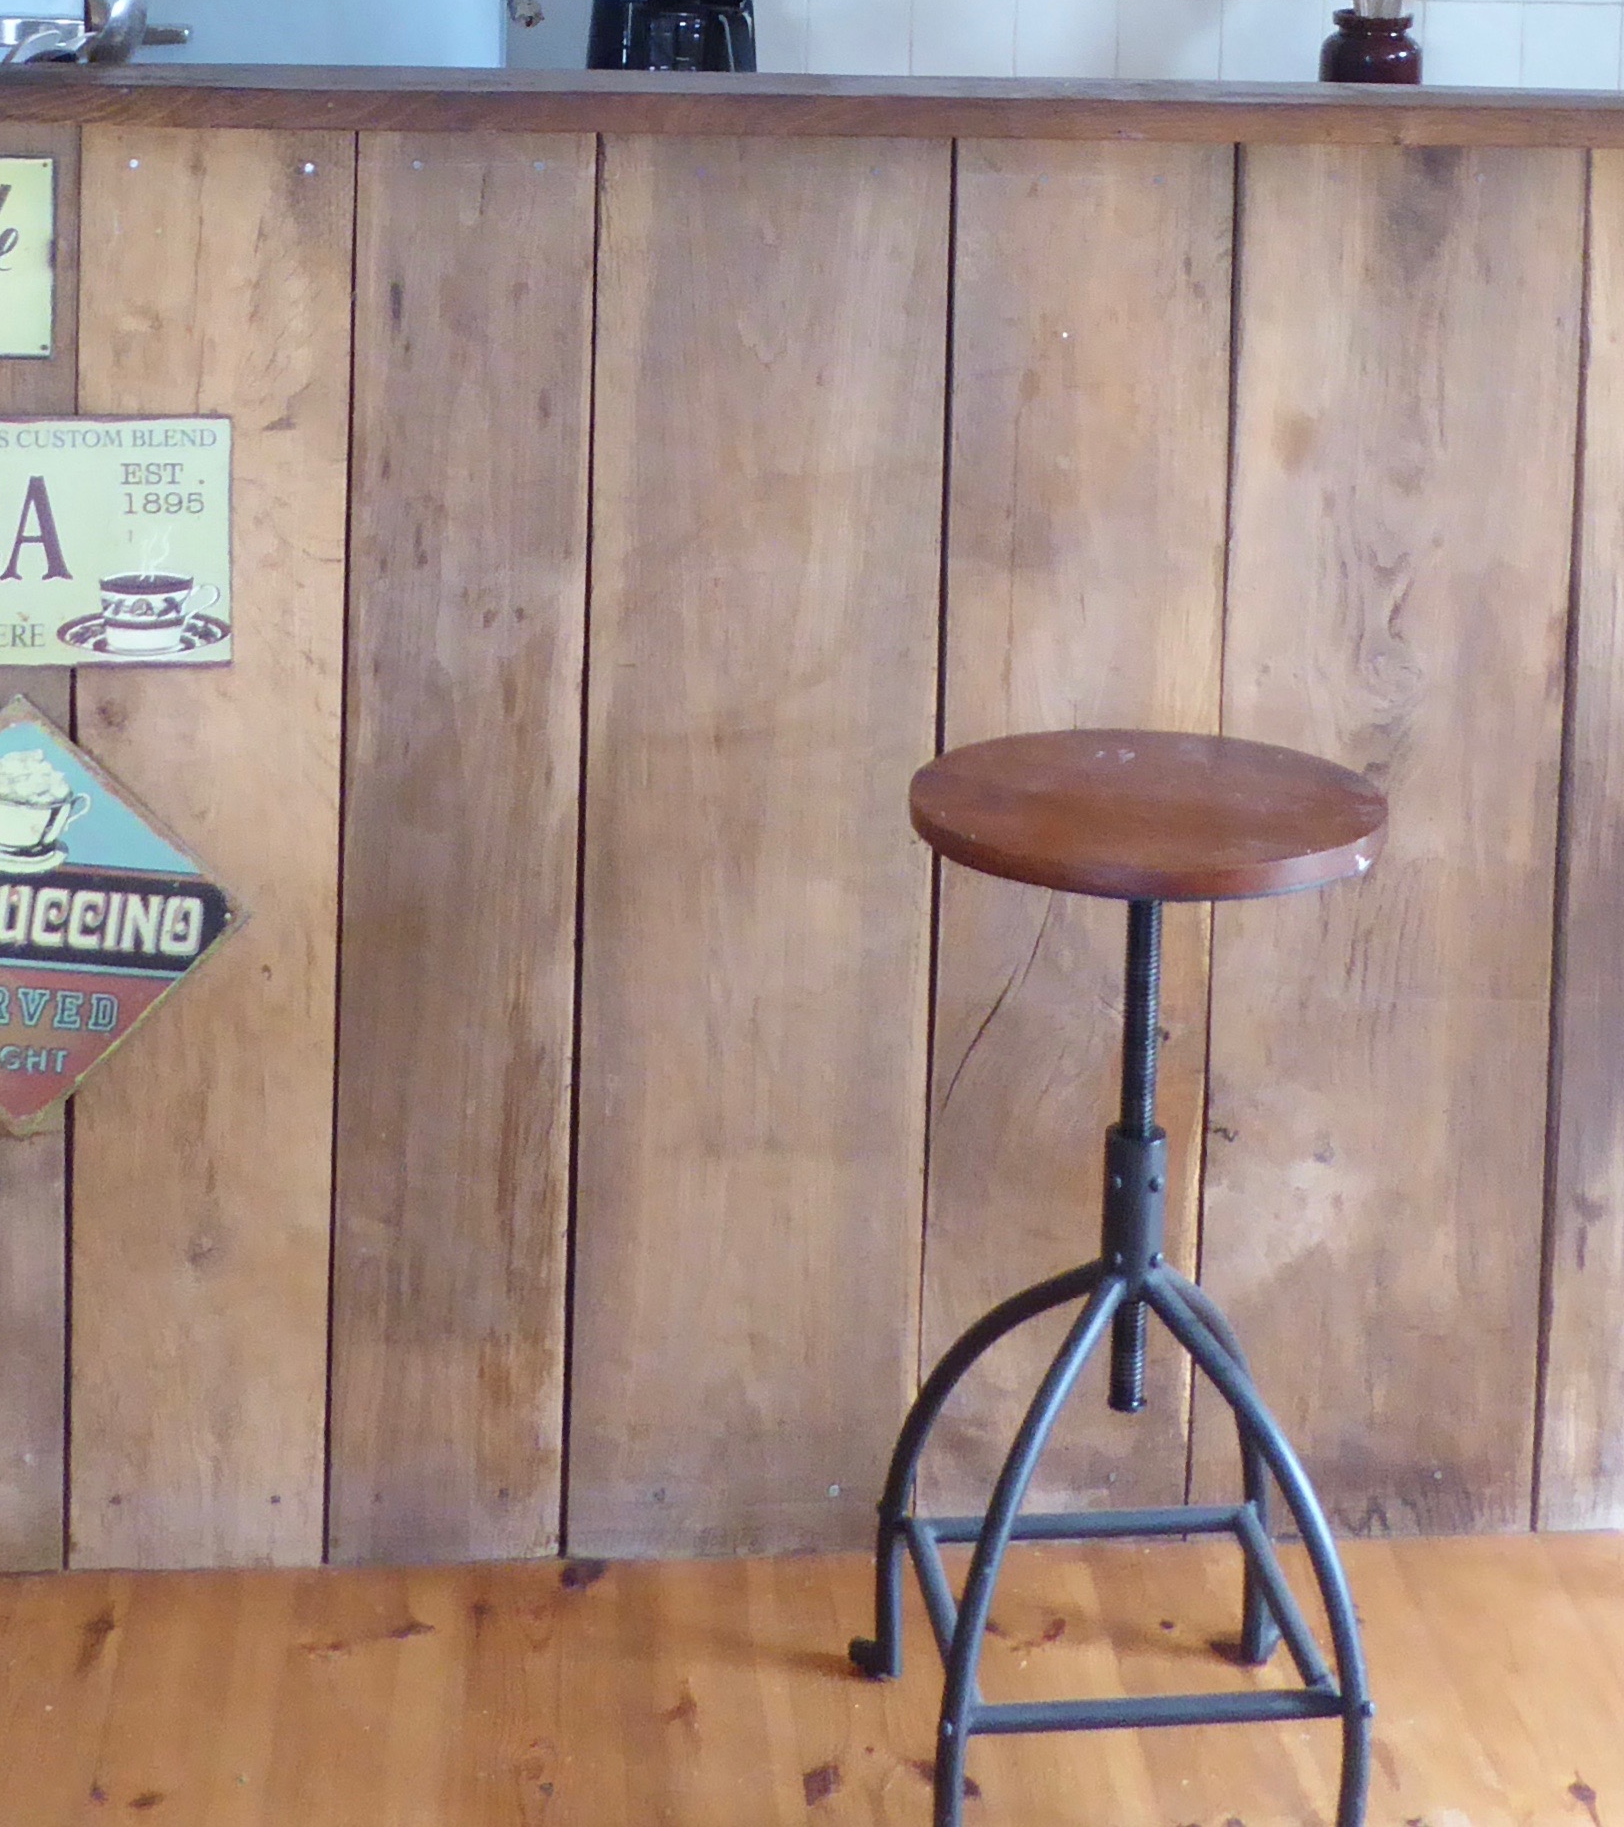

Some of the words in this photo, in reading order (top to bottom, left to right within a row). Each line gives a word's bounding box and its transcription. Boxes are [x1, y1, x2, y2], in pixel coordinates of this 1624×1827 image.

[16, 429, 124, 449] CUSTOM
[131, 429, 217, 448] BLEND
[123, 492, 205, 515] 1895
